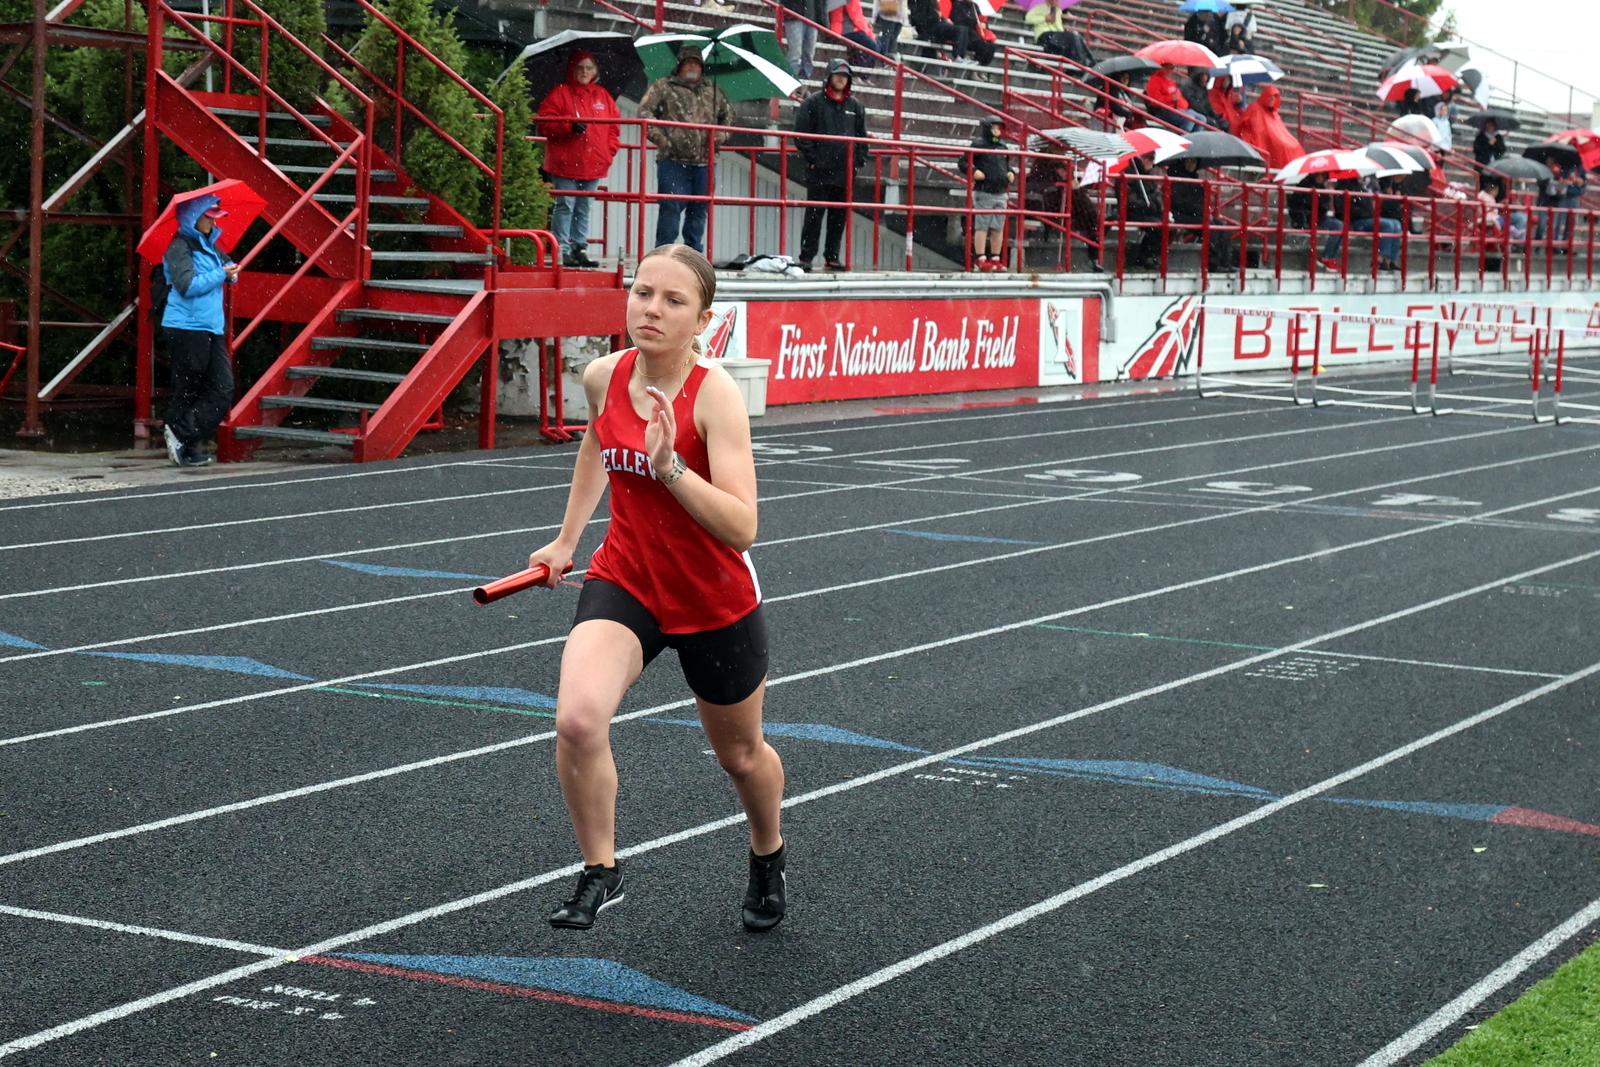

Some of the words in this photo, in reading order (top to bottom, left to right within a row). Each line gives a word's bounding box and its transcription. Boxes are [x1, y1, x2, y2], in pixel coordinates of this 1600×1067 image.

[1224, 307, 1276, 318] BELLEVUE
[1341, 315, 1396, 325] BELLEVUE
[1234, 302, 1535, 359] BELLEVUE
[1457, 322, 1517, 332] BELLEVUE
[775, 324, 827, 380] First
[829, 317, 919, 376] National
[919, 317, 970, 372] Bank
[971, 315, 1020, 370] Field
[601, 448, 656, 481] ELLEV
